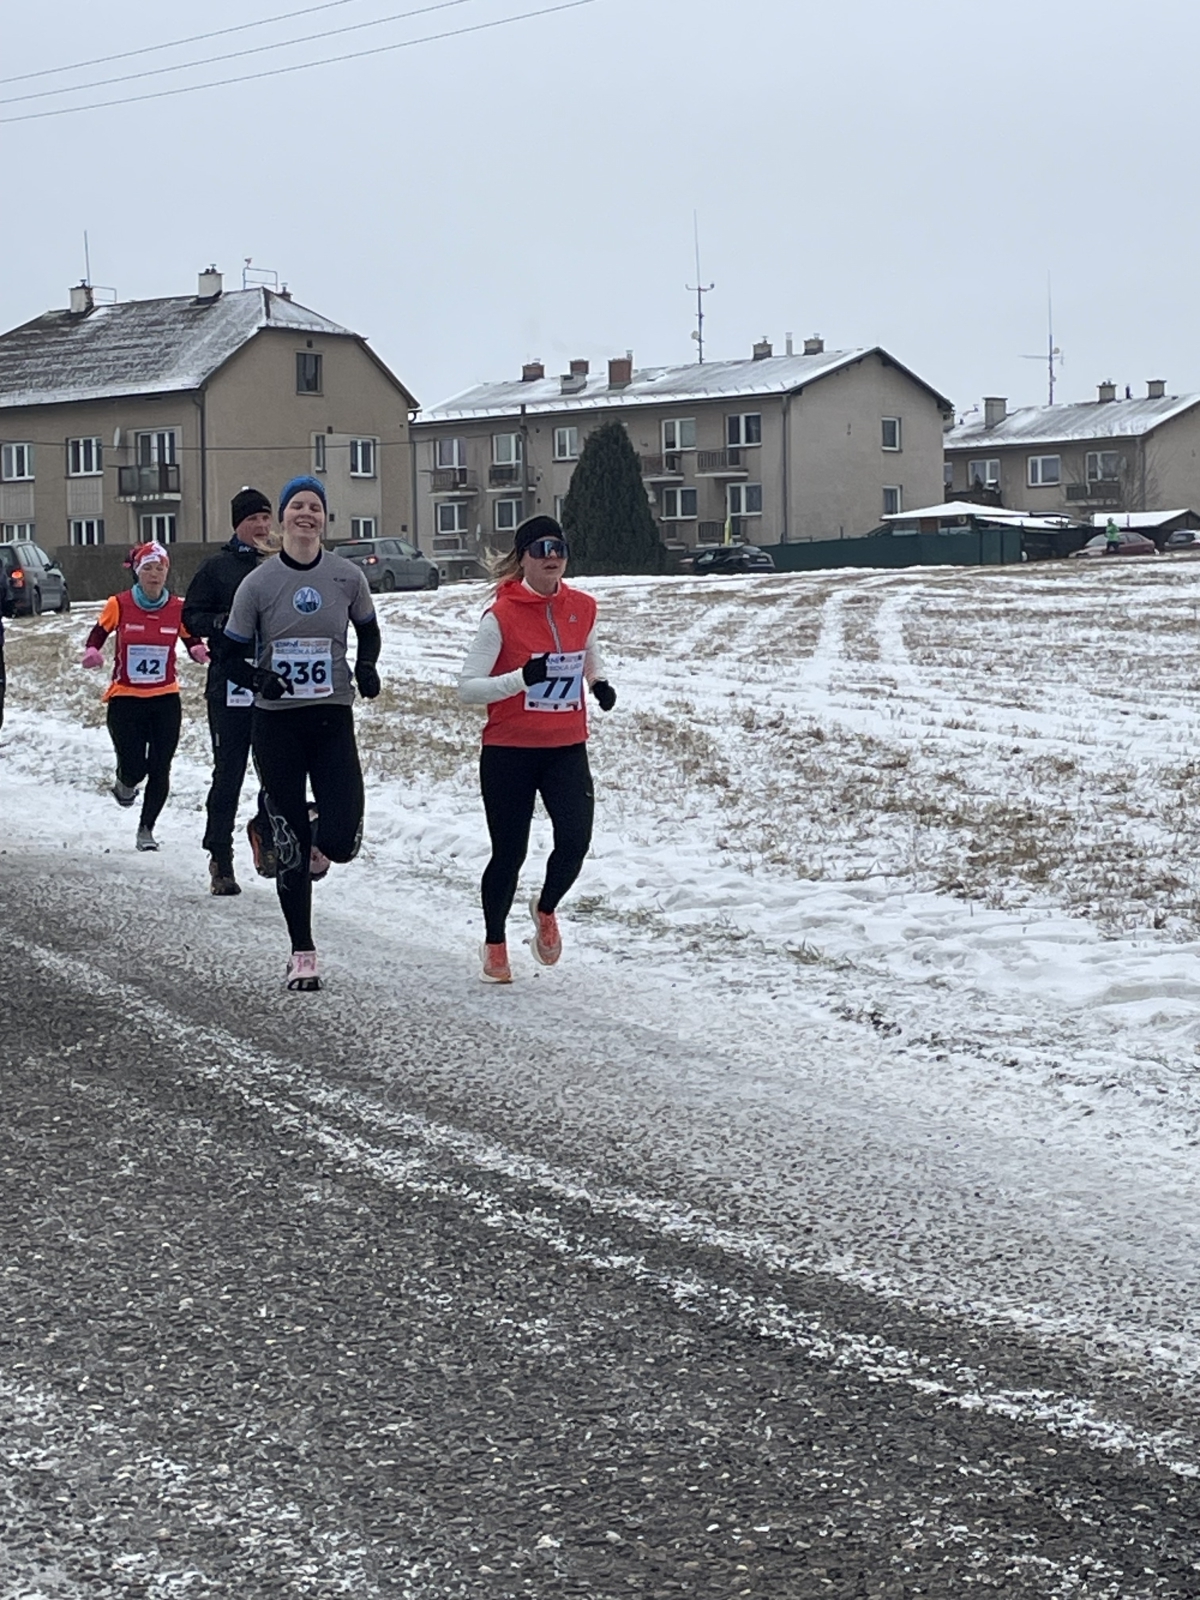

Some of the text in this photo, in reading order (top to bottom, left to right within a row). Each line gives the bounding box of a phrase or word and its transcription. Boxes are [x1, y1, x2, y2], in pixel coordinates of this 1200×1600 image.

[135, 659, 160, 675] 42
[276, 660, 326, 685] 236
[542, 676, 575, 699] 77
